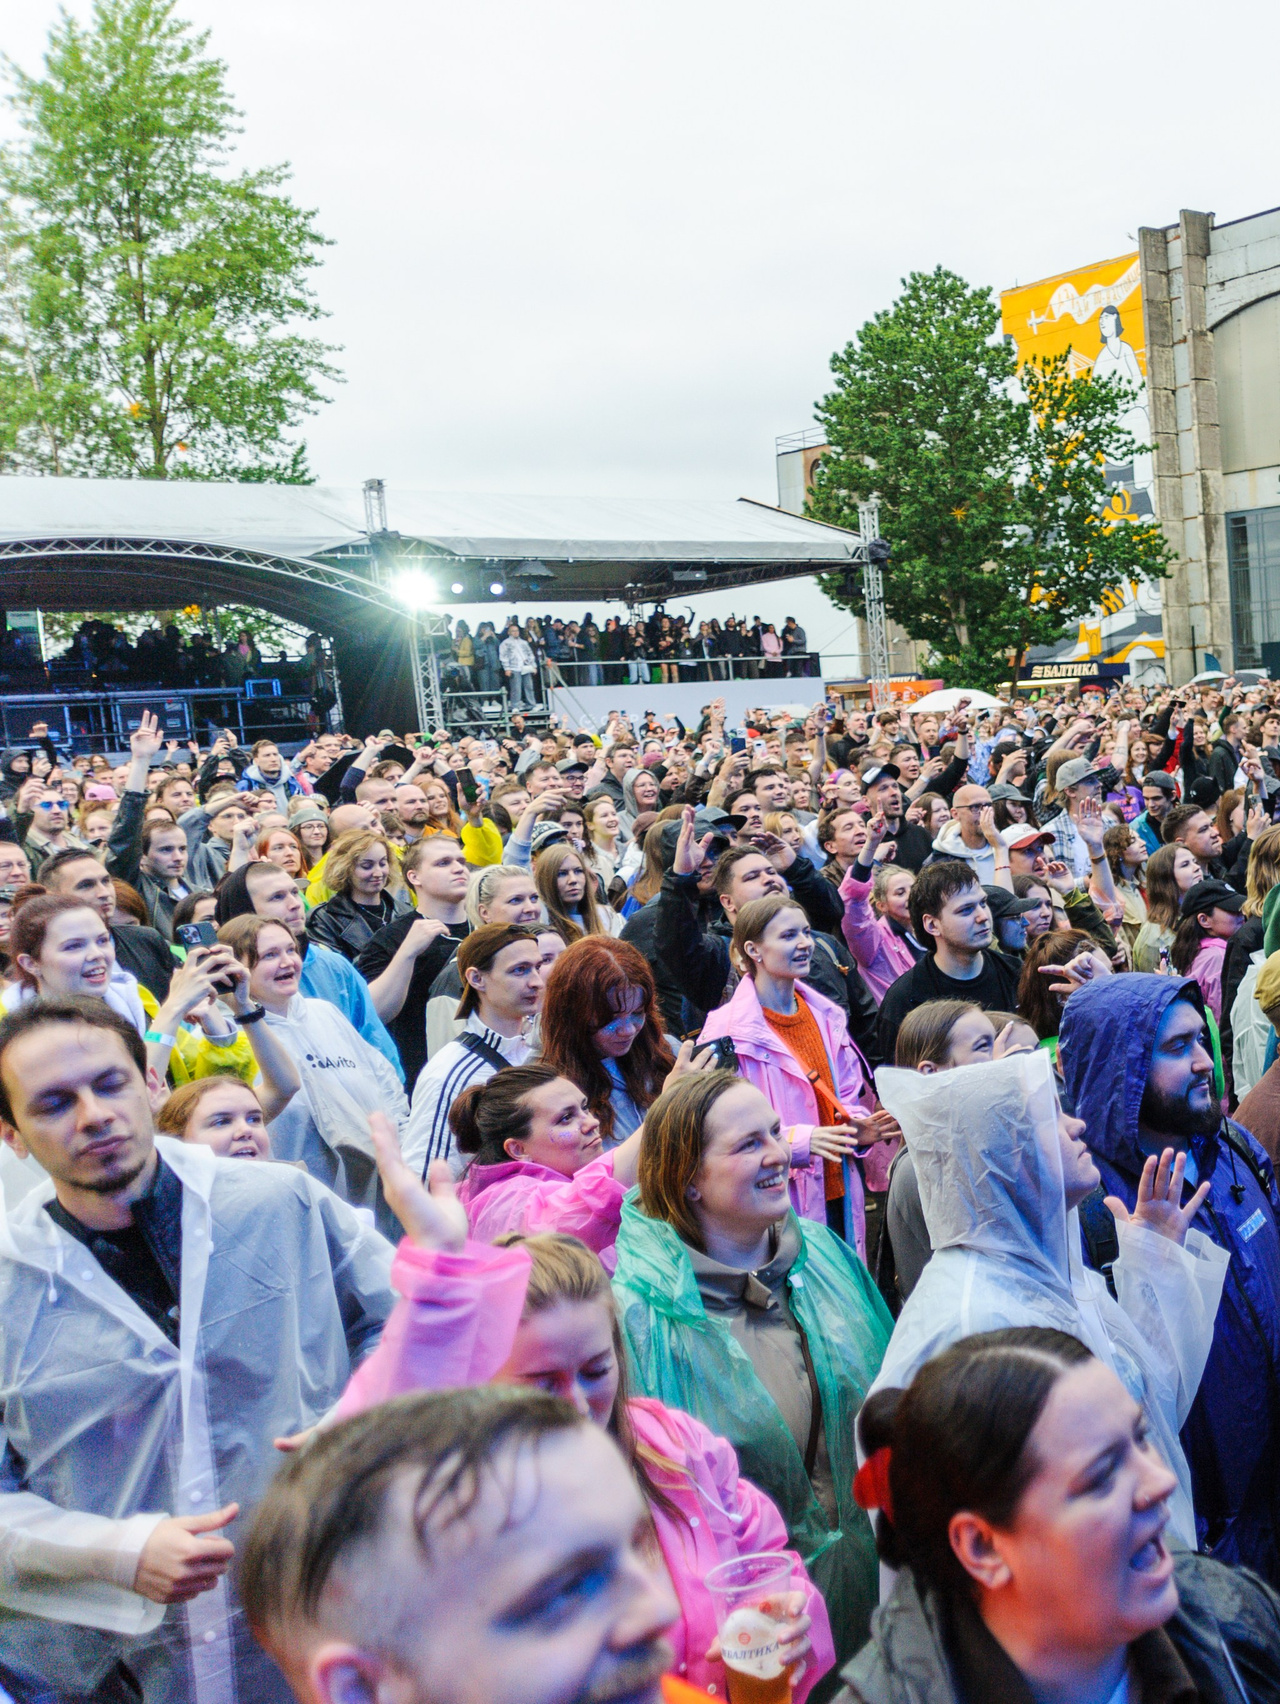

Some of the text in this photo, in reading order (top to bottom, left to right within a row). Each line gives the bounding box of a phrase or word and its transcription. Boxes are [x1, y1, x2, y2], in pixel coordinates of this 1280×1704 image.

[1043, 663, 1098, 677] БАЛТИКА
[325, 1056, 356, 1069] Avito
[727, 1641, 779, 1659] БАЛТИКА
